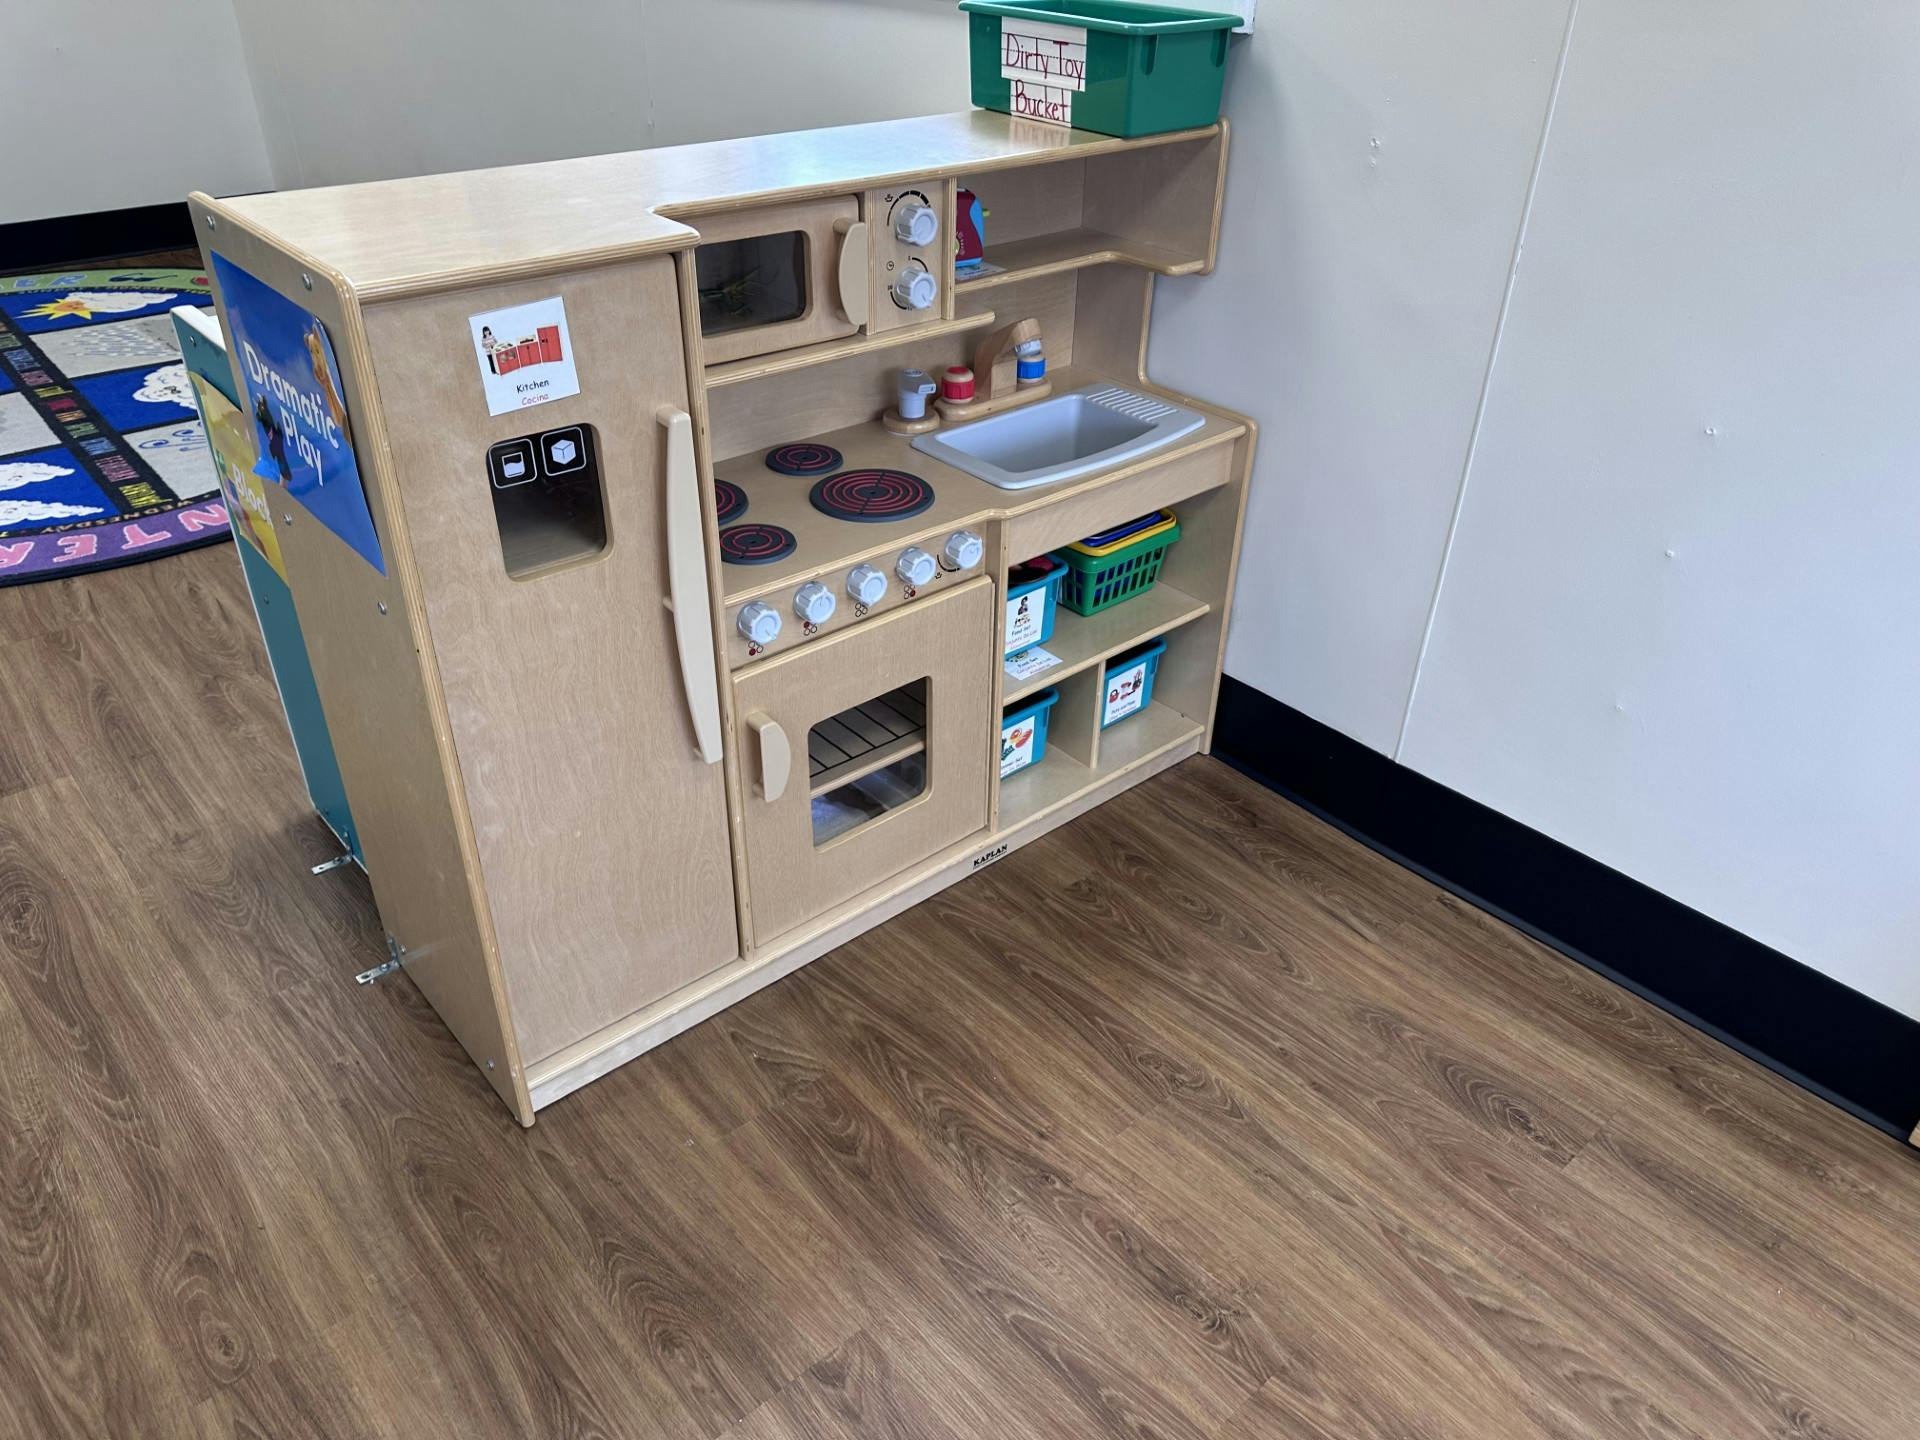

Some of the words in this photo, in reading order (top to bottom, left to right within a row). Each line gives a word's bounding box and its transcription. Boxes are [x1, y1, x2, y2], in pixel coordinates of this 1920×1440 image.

[1006, 33, 1049, 79] Dirty
[1053, 40, 1084, 90] Toy
[1015, 79, 1069, 122] Bucket
[243, 340, 340, 450] Dramatic
[516, 380, 549, 394] Kitchen
[521, 393, 549, 406] Cocina
[279, 405, 325, 488] Play
[41, 499, 193, 534] WEDNESDAY
[973, 843, 1008, 867] KAPLAN
